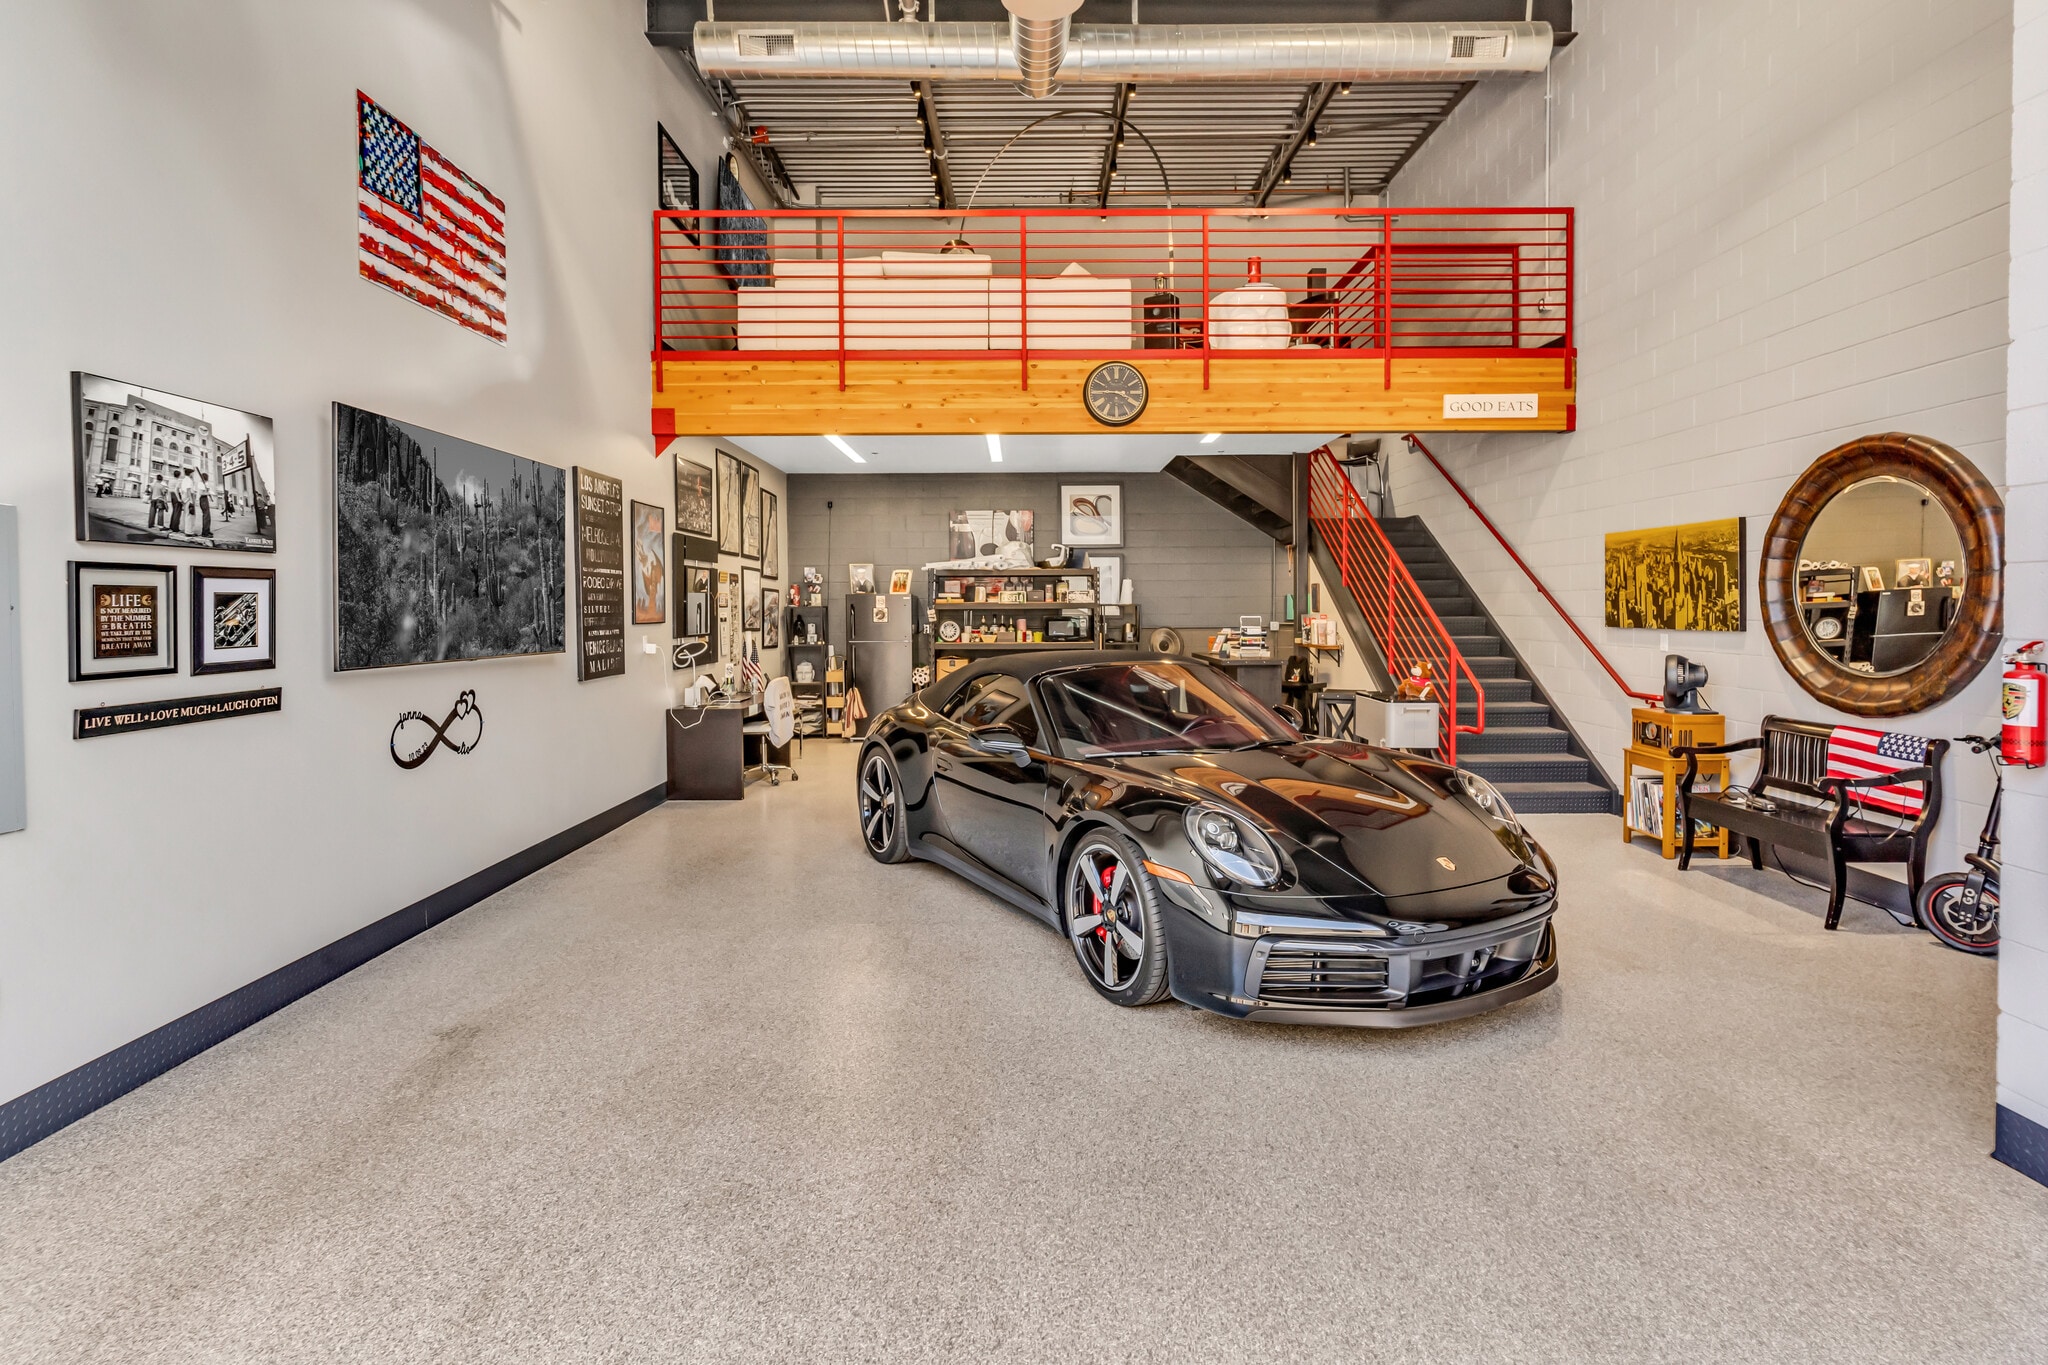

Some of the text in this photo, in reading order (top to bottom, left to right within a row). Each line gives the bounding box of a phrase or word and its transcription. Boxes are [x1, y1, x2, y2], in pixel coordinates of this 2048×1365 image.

[1449, 401, 1534, 412] GOOD EATS
[580, 473, 592, 492] LOS
[581, 494, 604, 514] SUNSET
[583, 576, 605, 588] RODEO
[112, 594, 141, 606] LIFE
[84, 696, 278, 730] LIVE WELL LOVE MUCH LAUGH OFTEN
[1962, 888, 1977, 905] GO
